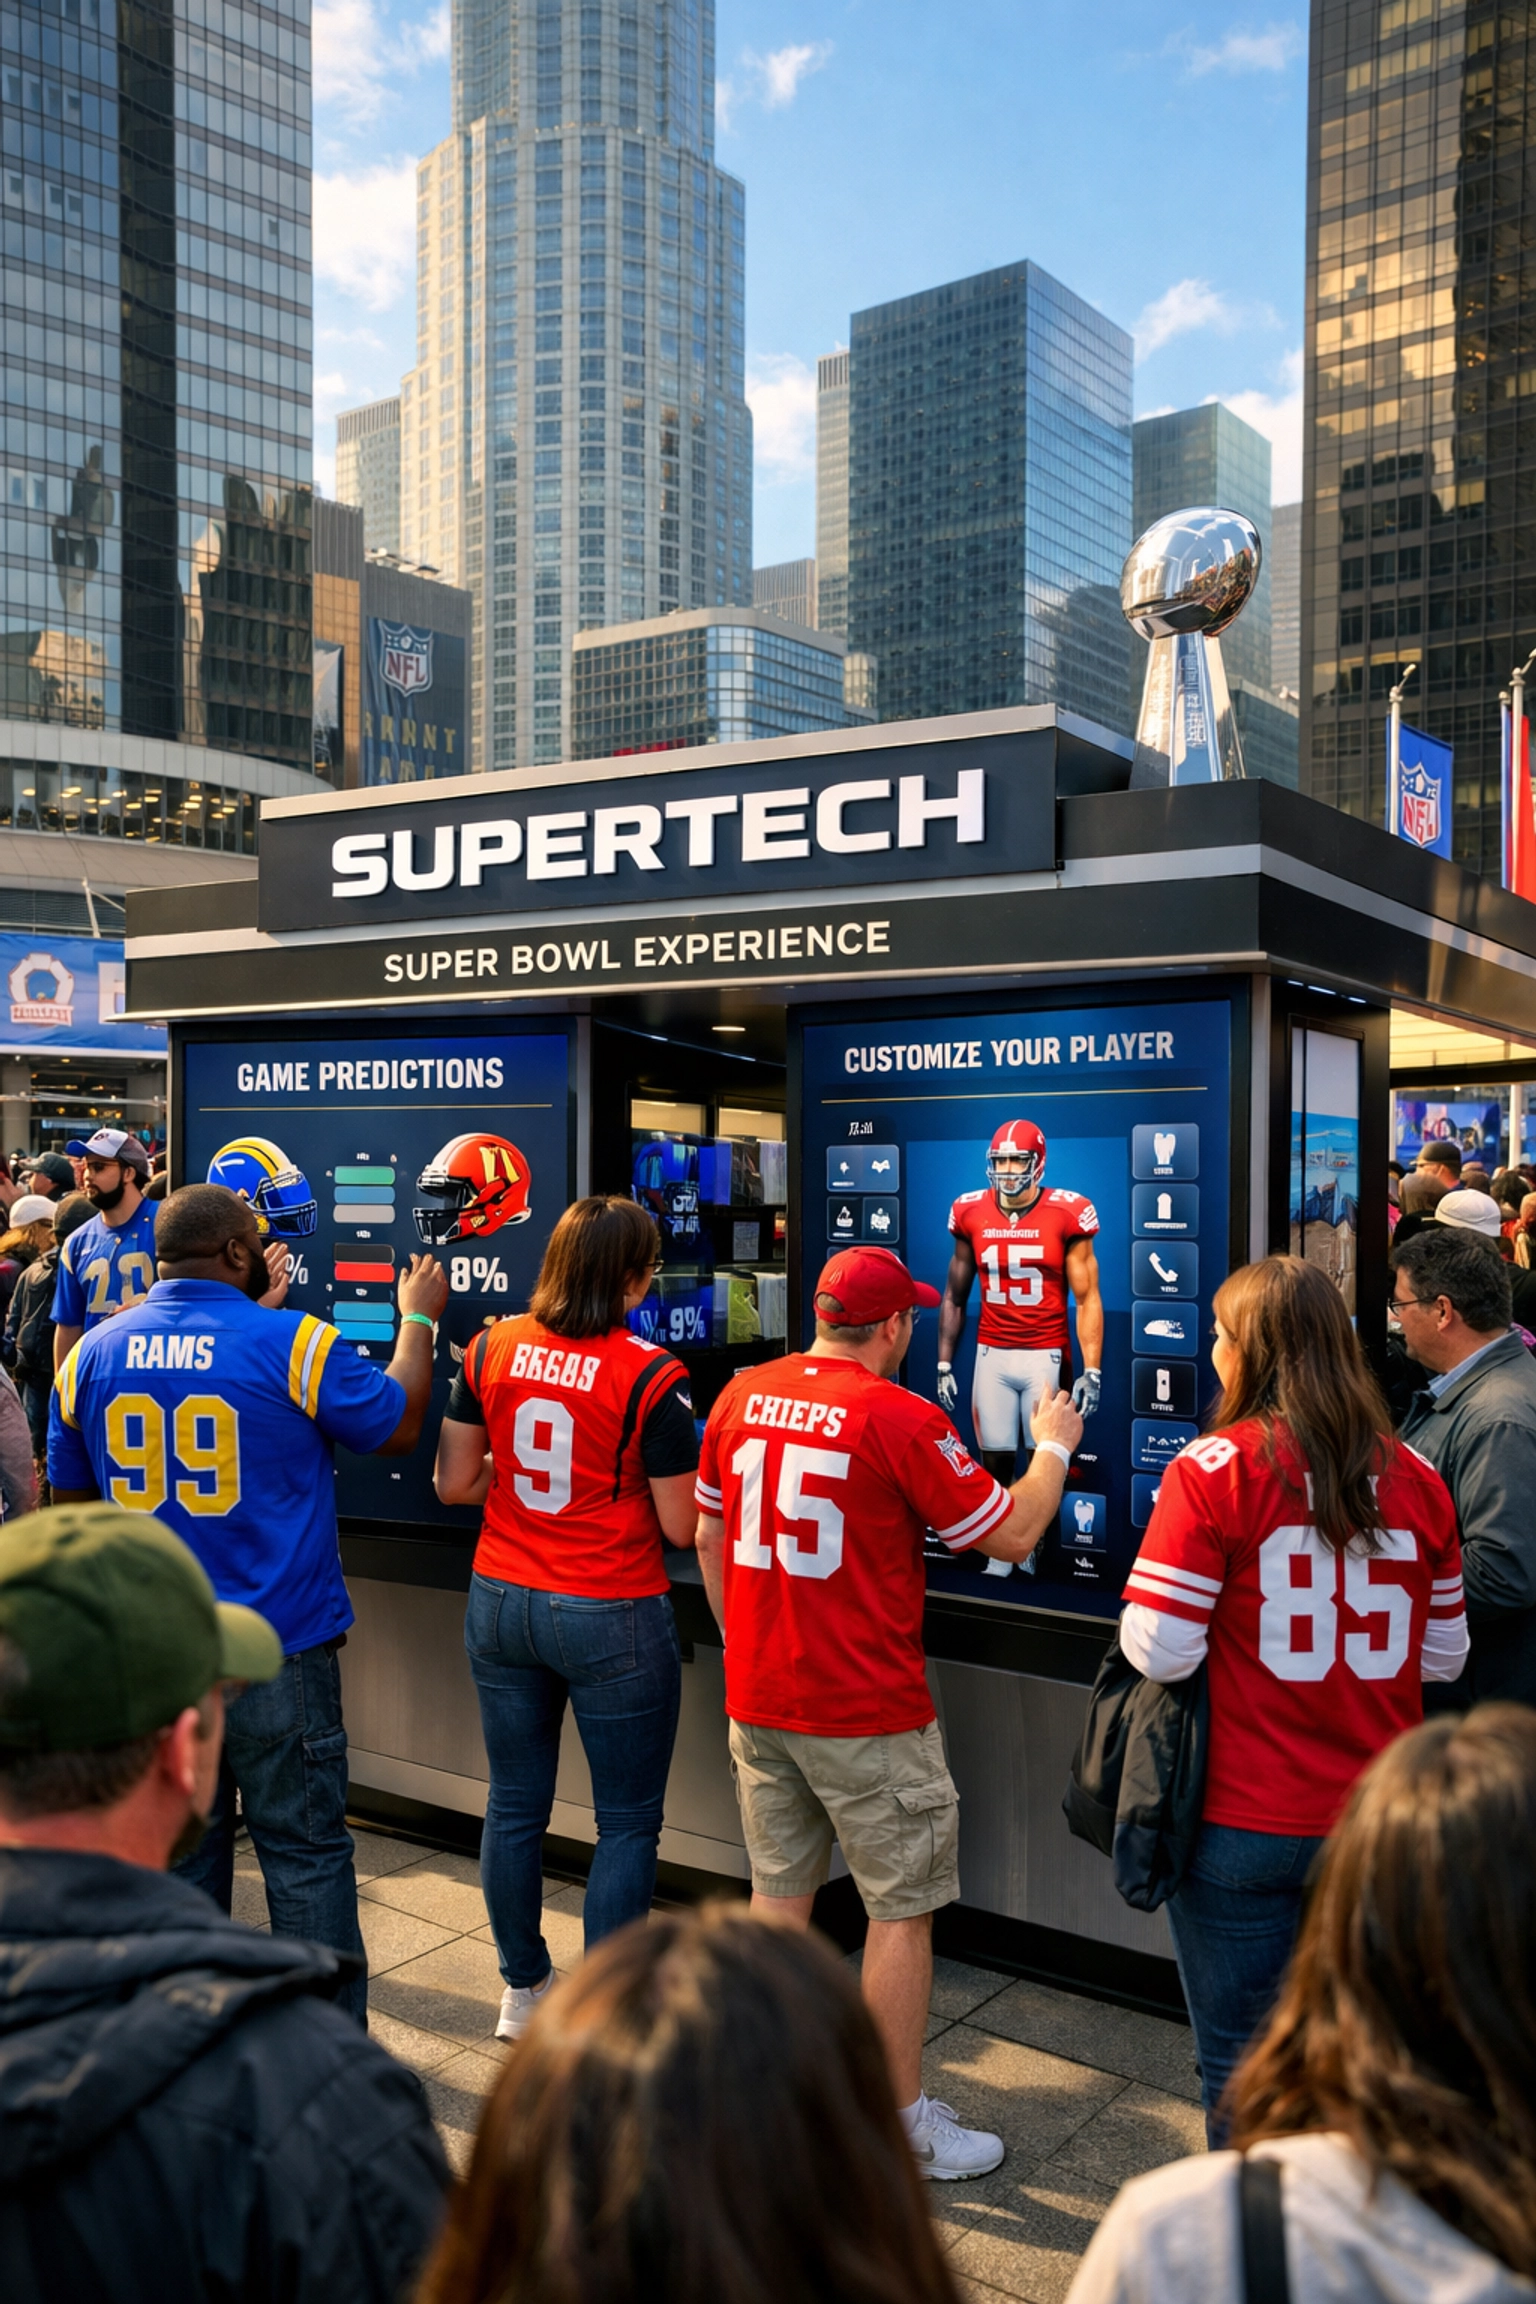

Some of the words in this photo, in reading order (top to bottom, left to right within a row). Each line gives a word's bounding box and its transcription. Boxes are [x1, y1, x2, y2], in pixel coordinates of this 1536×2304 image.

[386, 651, 427, 686] NFL
[331, 768, 985, 898] SUPERTECH
[384, 947, 499, 983] SUPER
[511, 939, 622, 975] BOWL
[634, 920, 891, 968] EXPERIENCE
[237, 1062, 310, 1092] GAME
[318, 1057, 504, 1090] PREDICTIONS
[844, 1040, 983, 1074] CUSTOMIZE
[990, 1036, 1062, 1067] YOUR
[1070, 1030, 1175, 1064] PLAYER
[981, 1244, 1045, 1306] 15
[126, 1335, 215, 1370] RAMS
[105, 1392, 241, 1517] 99
[513, 1397, 575, 1515] 9
[731, 1438, 852, 1580] 15
[1259, 1525, 1418, 1682] 85
